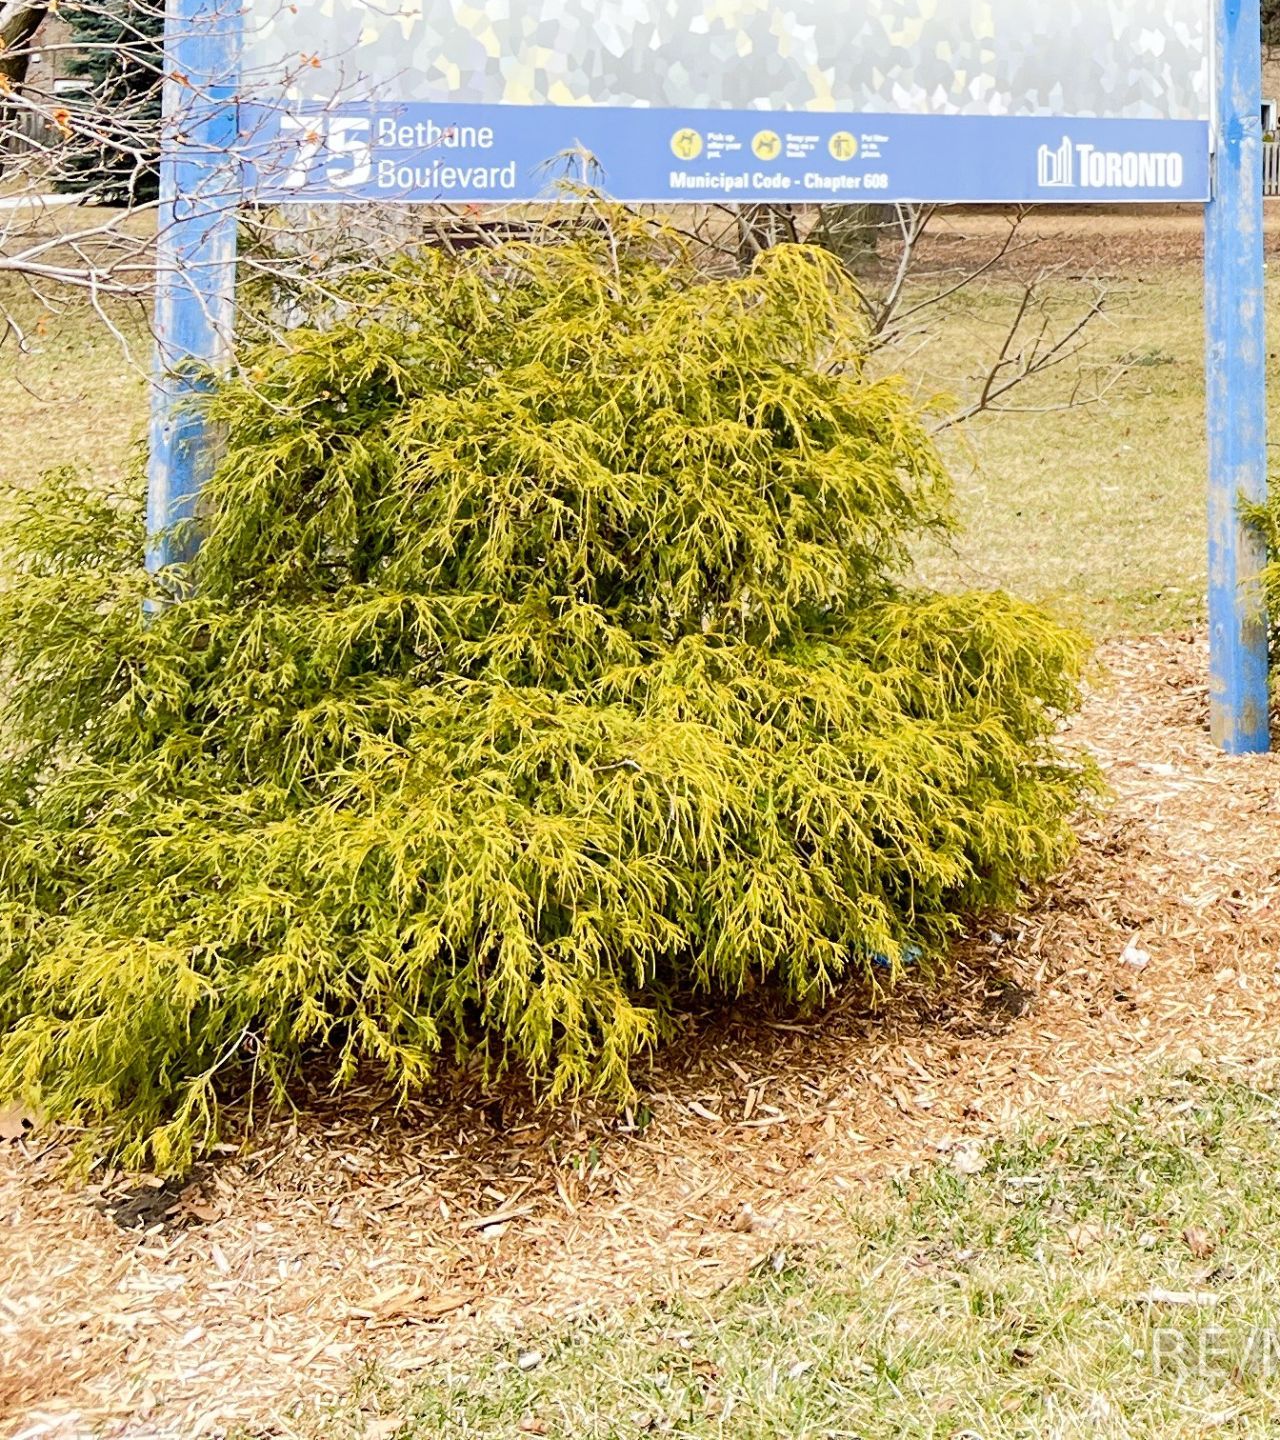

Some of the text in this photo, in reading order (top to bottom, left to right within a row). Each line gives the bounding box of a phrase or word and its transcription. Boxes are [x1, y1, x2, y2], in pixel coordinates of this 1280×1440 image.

[379, 118, 494, 148] Bethune
[280, 116, 371, 187] 75
[1075, 143, 1183, 188] TORONTO
[378, 160, 516, 189] Boulevard
[669, 171, 749, 192] Municipal
[752, 172, 791, 189] Code
[804, 173, 861, 192] Chapter
[863, 173, 888, 189] 608
